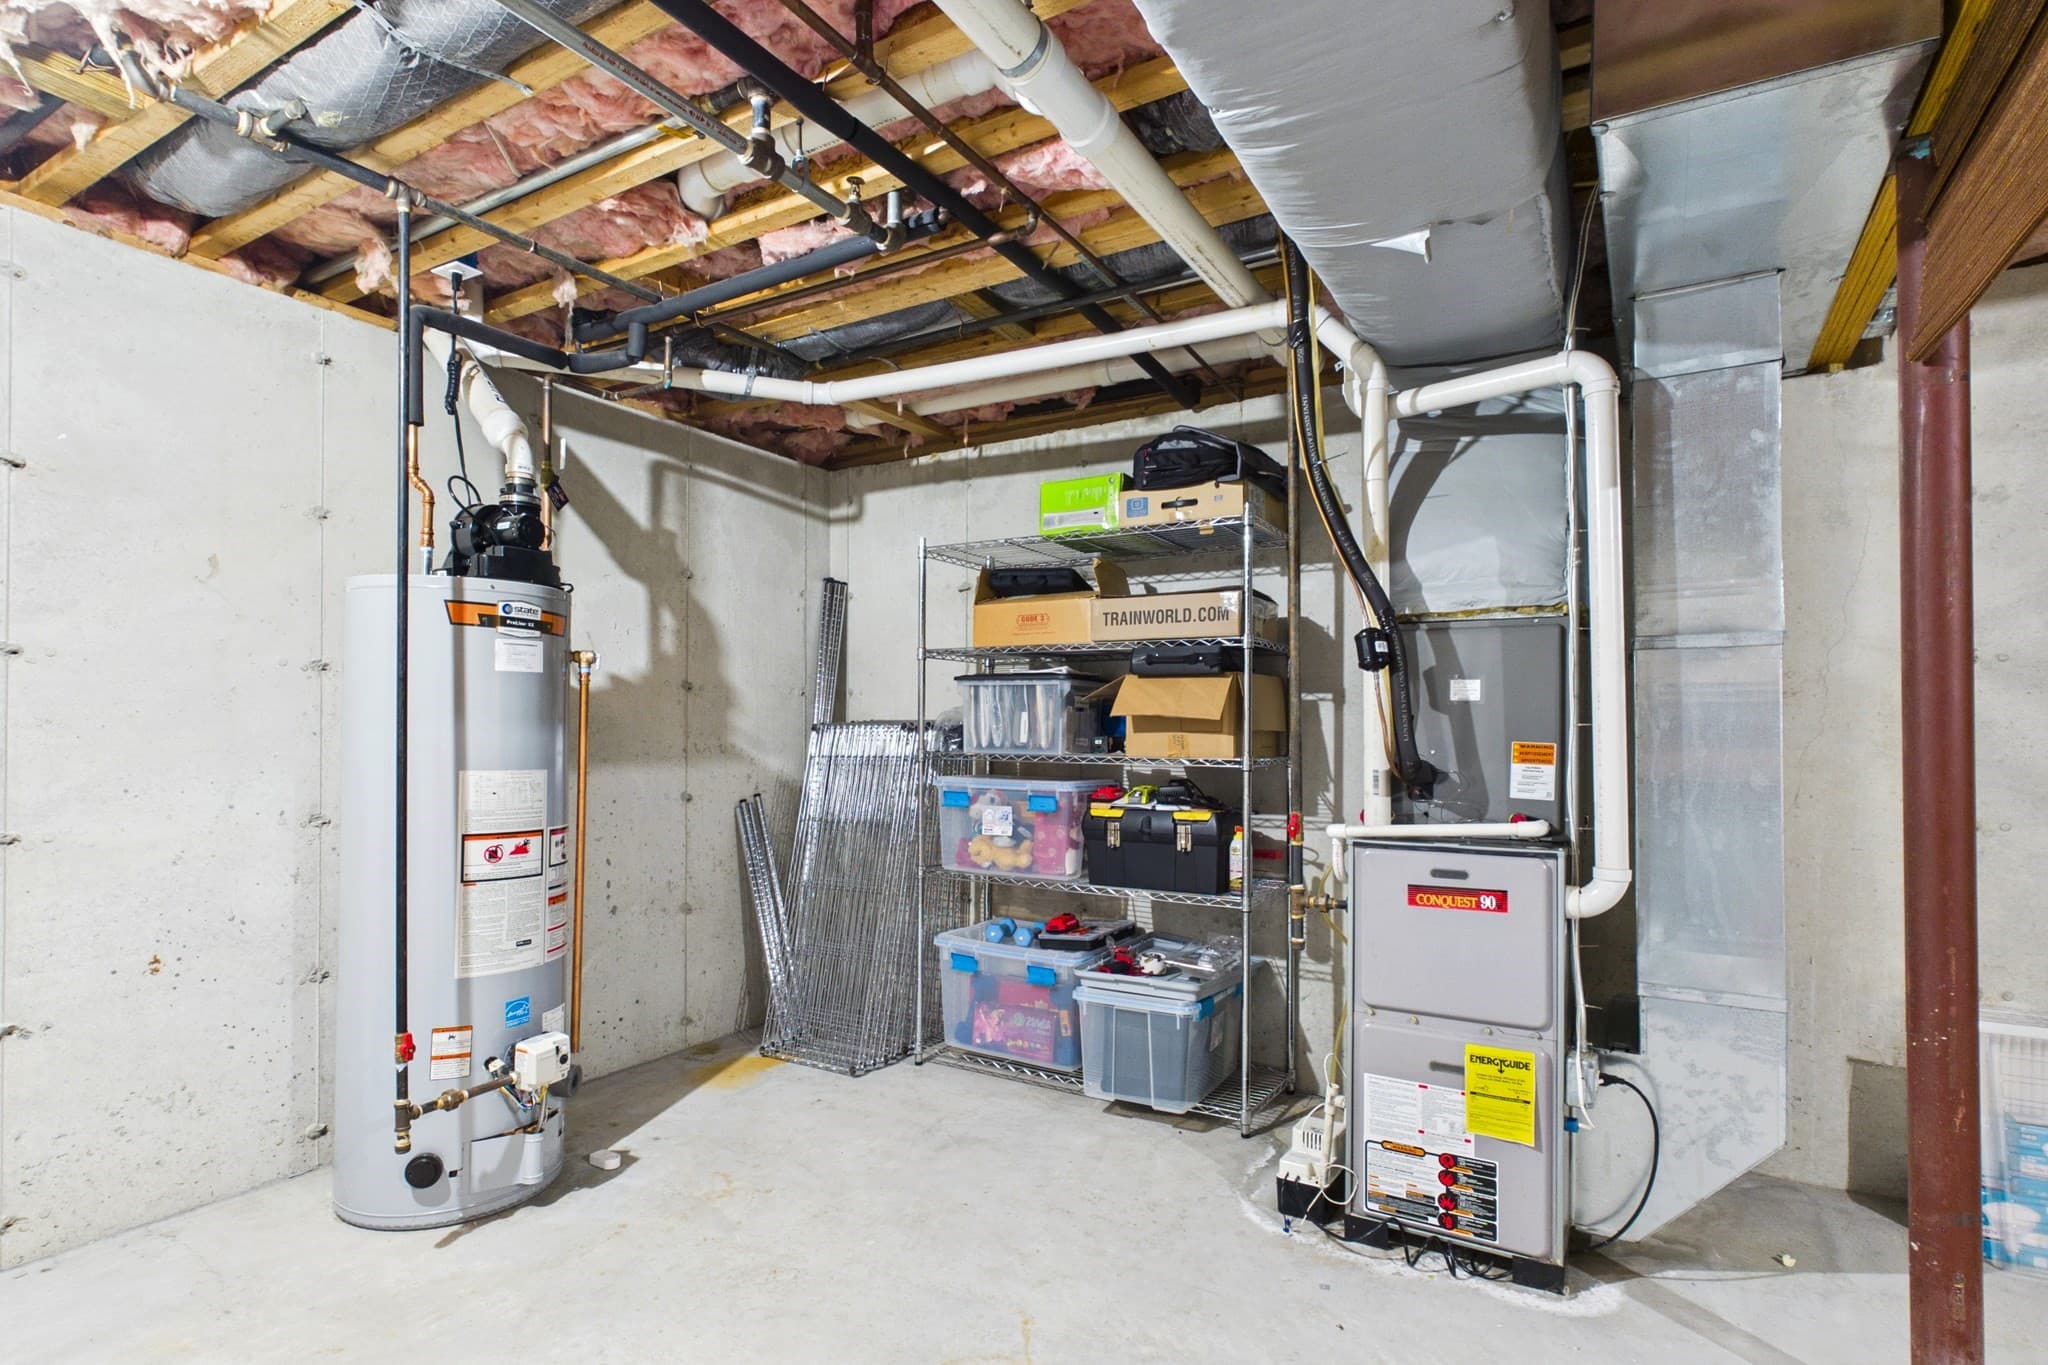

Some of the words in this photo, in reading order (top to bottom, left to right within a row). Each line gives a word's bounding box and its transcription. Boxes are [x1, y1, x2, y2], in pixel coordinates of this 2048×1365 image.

[514, 606, 539, 615] state
[1102, 606, 1230, 626] TRAINWORLD.COM
[1415, 893, 1478, 909] CONQUEST
[1480, 895, 1496, 910] 90
